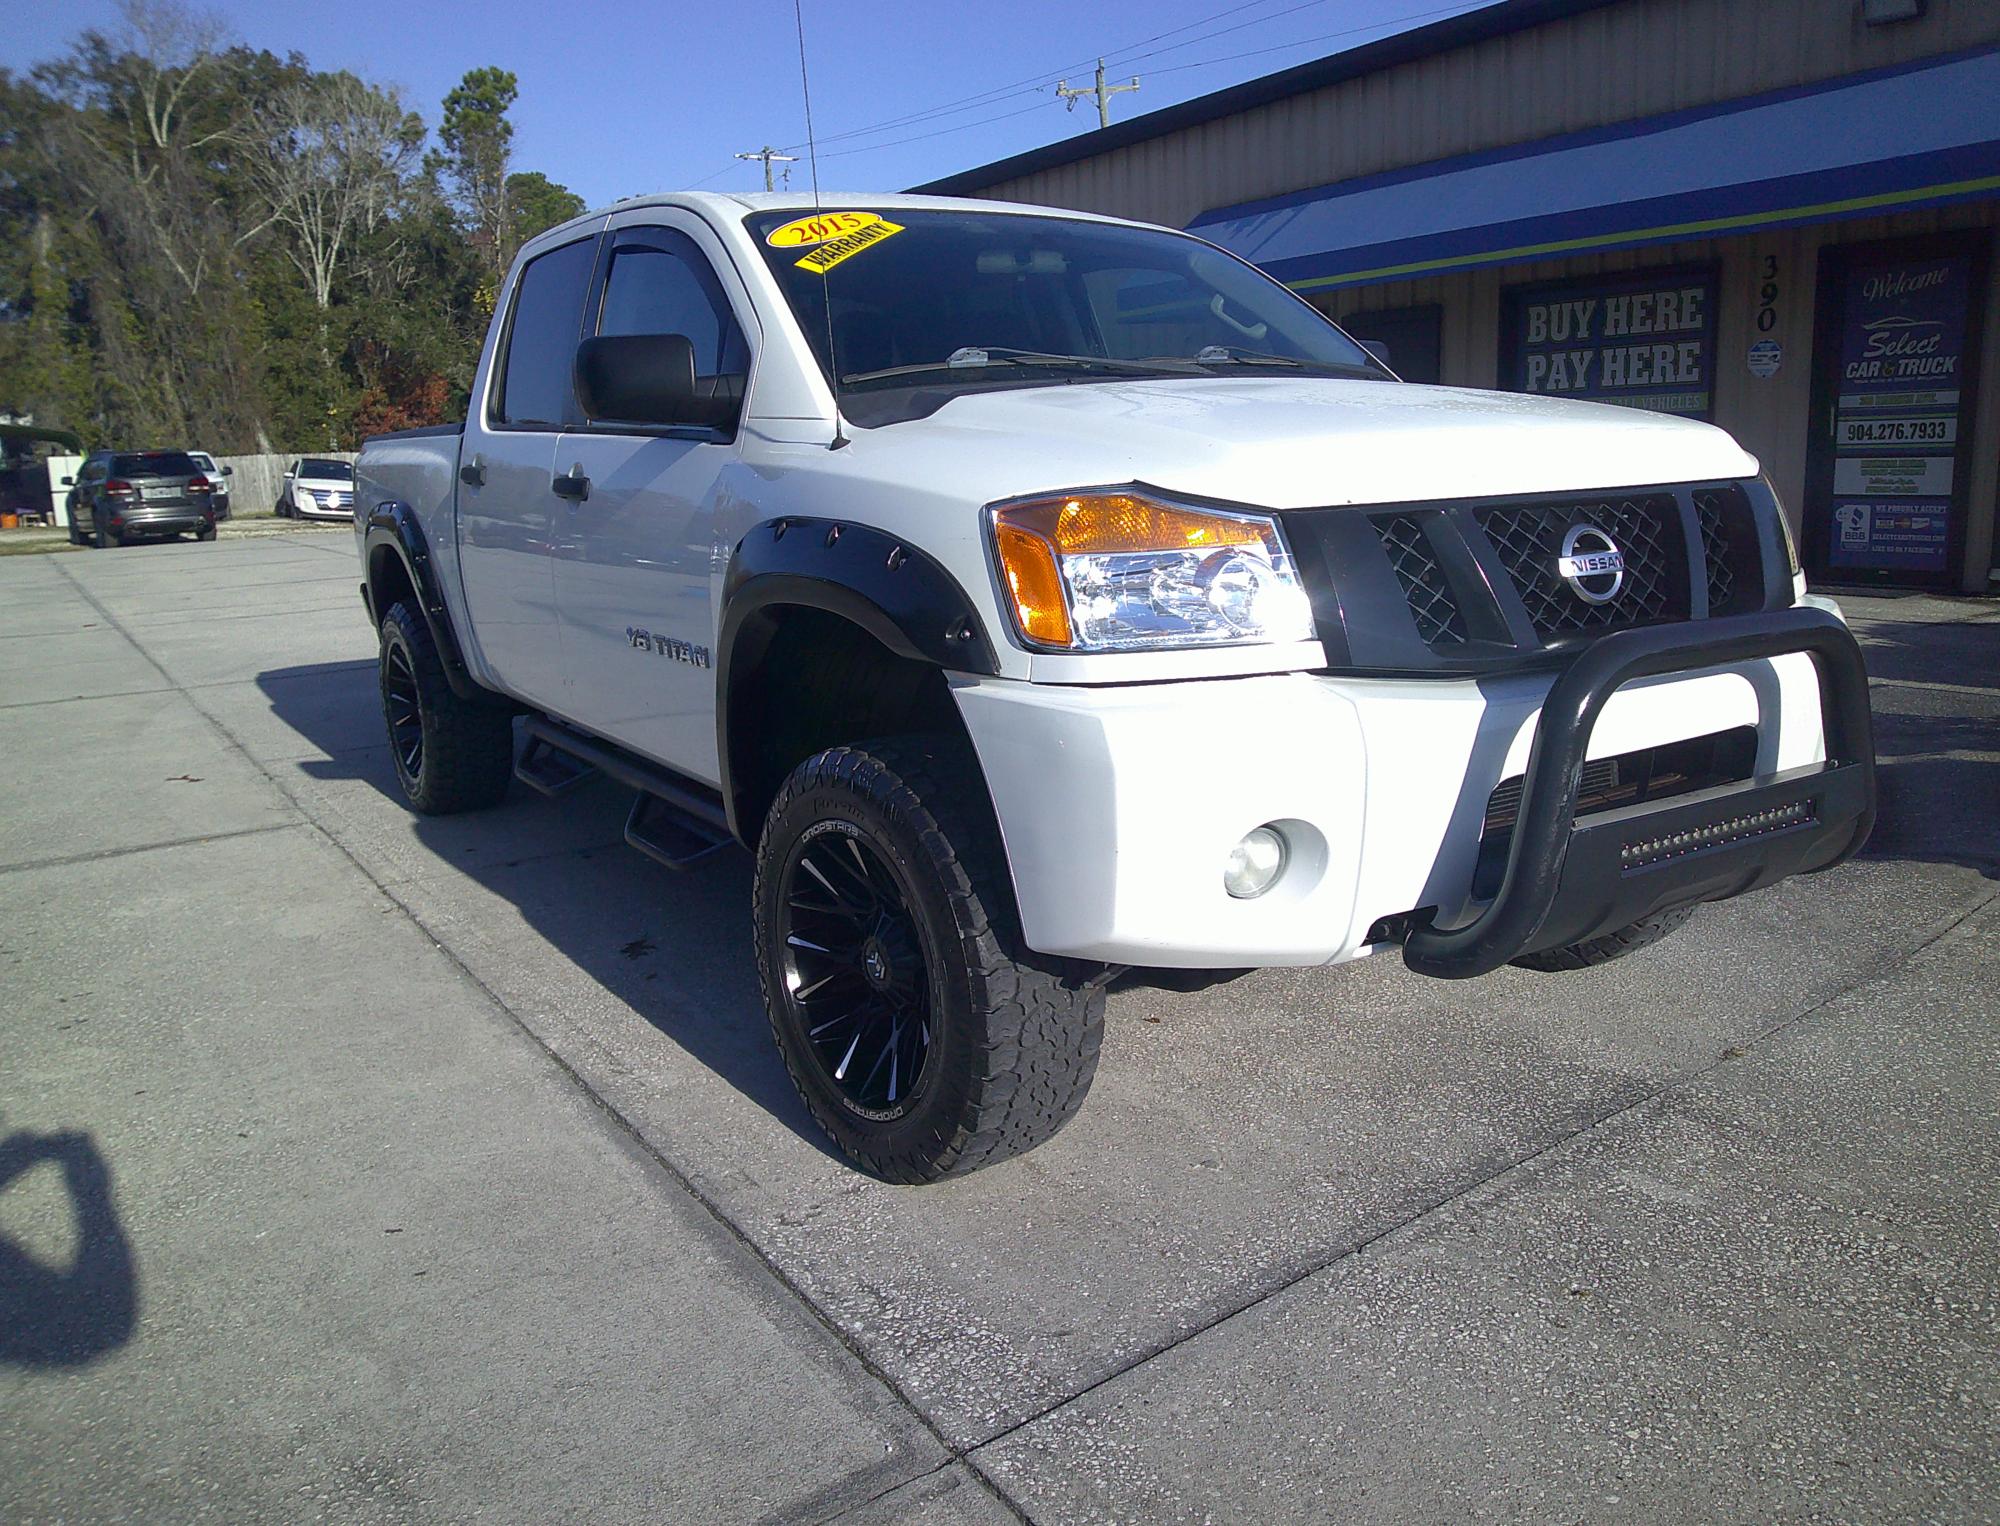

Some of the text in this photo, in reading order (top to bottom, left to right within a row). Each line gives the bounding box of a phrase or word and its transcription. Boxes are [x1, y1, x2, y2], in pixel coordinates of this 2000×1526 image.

[790, 214, 861, 243] 2015
[804, 222, 889, 266] WARRANTY
[1757, 254, 1778, 332] 390
[1863, 267, 1949, 302] Welcome
[1527, 287, 1705, 343] BUY HERE
[1863, 331, 1941, 358] Select
[1526, 341, 1702, 392] PAY HERE
[1846, 360, 1881, 379] CAR
[1897, 355, 1958, 376] TRUCK
[1641, 394, 1701, 411] VEHICLES
[1847, 421, 1946, 441] 904.276.7933
[1844, 531, 1866, 541] BBB
[1571, 556, 1624, 573] NISSAN
[652, 633, 710, 669] TITAN
[801, 820, 860, 844] DROPSTARS
[843, 1097, 904, 1121] DROPSTARS
